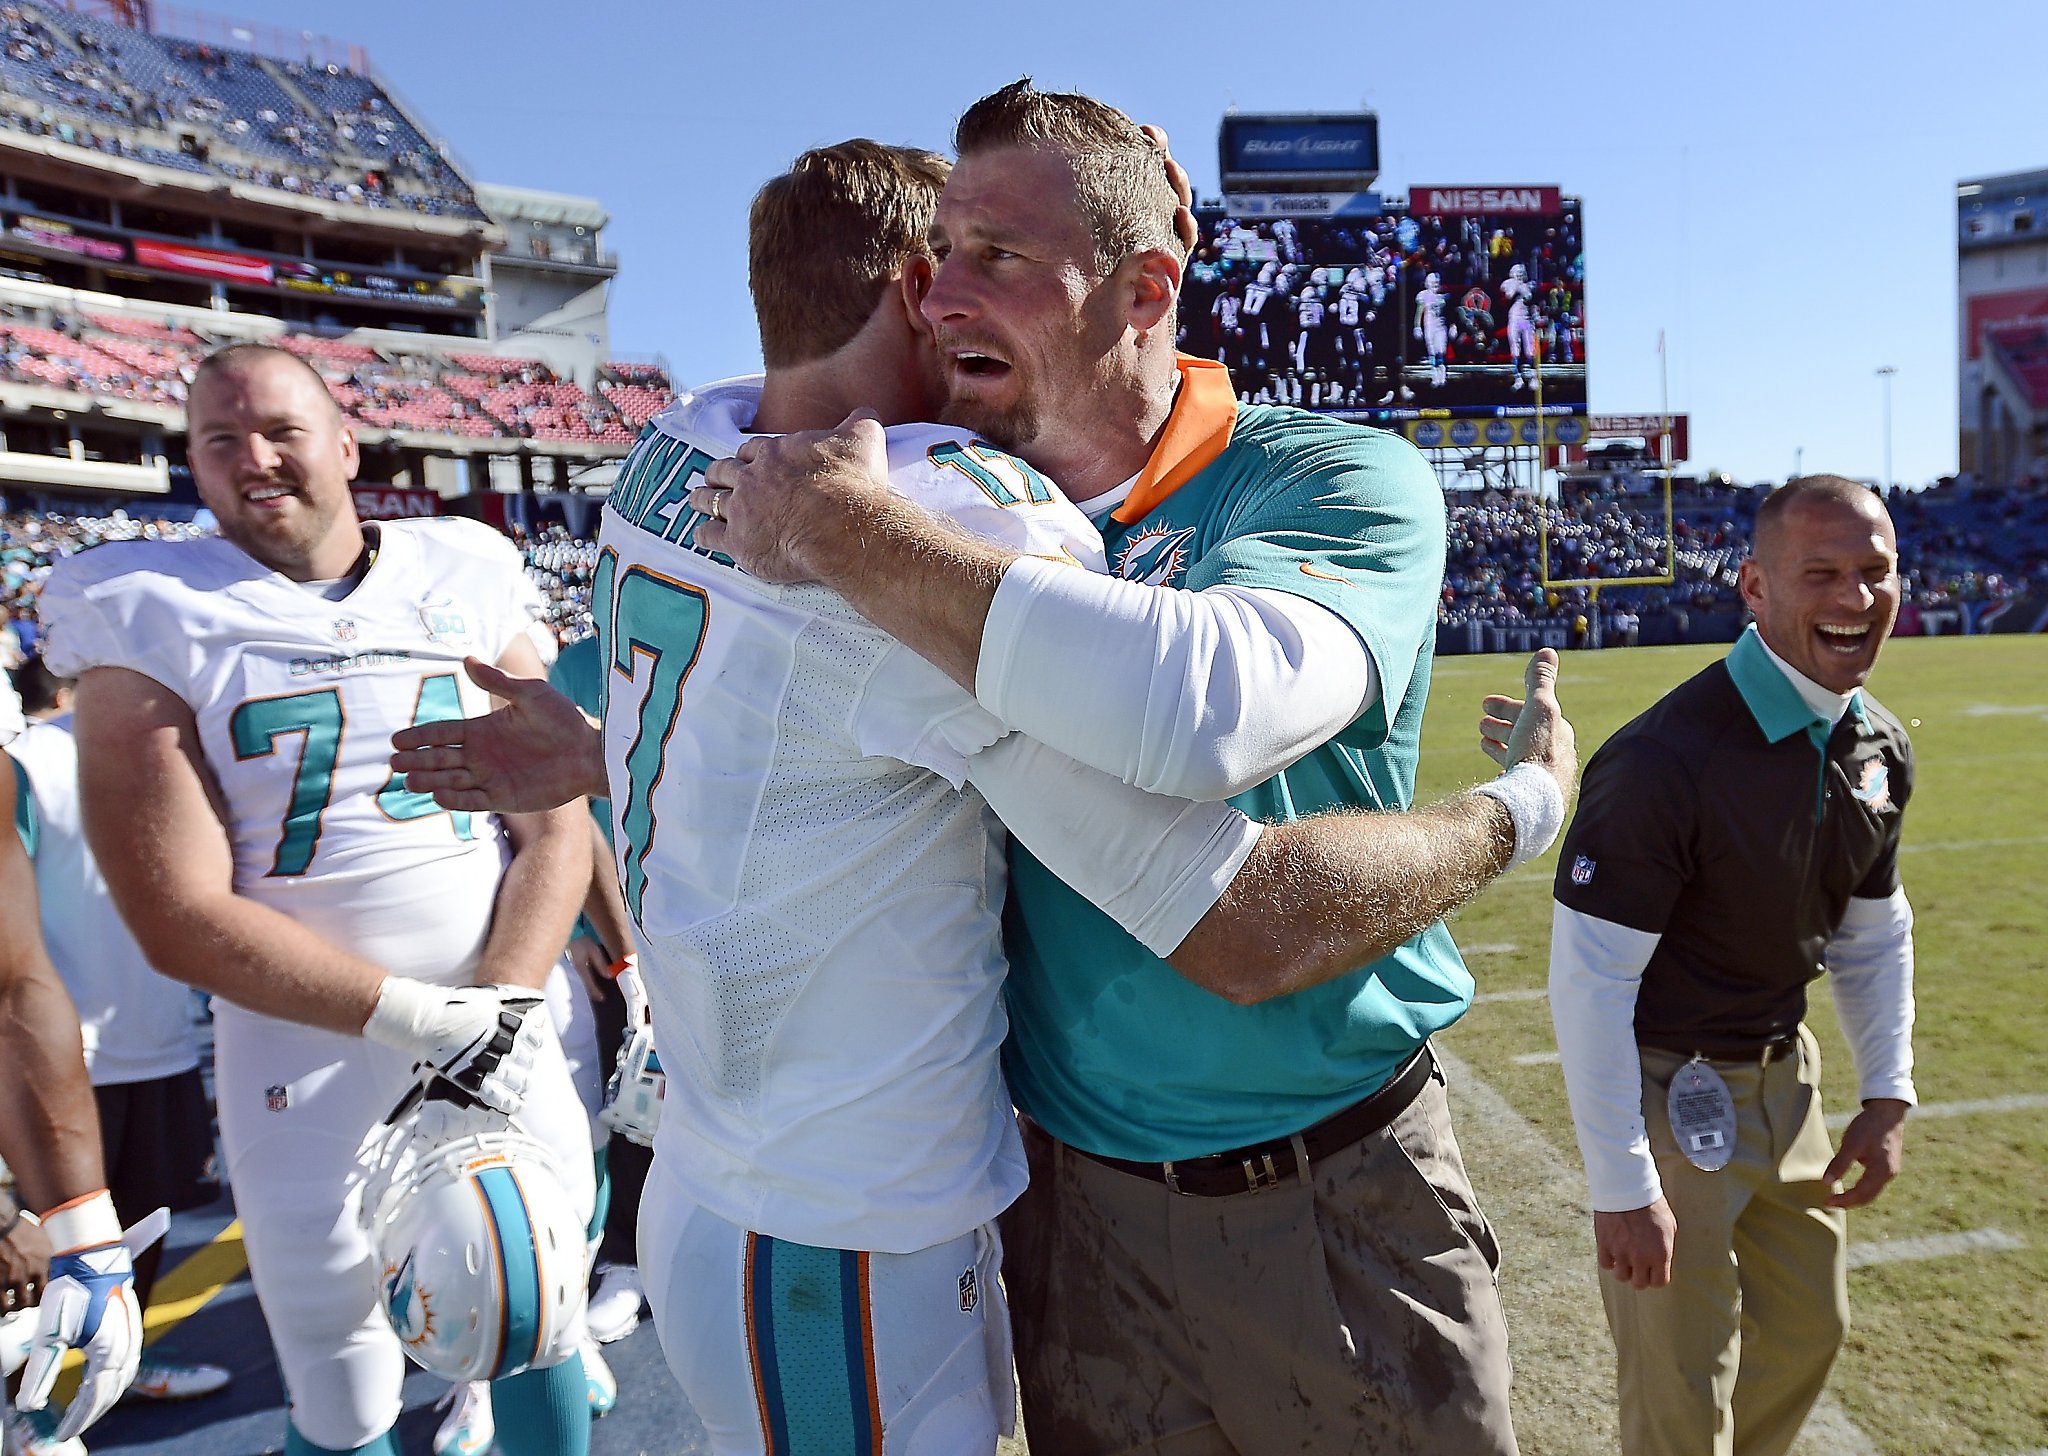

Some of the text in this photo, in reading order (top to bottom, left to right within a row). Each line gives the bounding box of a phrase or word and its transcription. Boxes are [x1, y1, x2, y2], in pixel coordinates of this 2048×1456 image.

[1244, 138, 1362, 155] BUD LIGHT
[1429, 190, 1541, 211] NISSAN
[1589, 416, 1675, 430] NISSAN
[926, 439, 1056, 509] 17
[356, 492, 436, 518] SAN
[229, 672, 478, 877] 74
